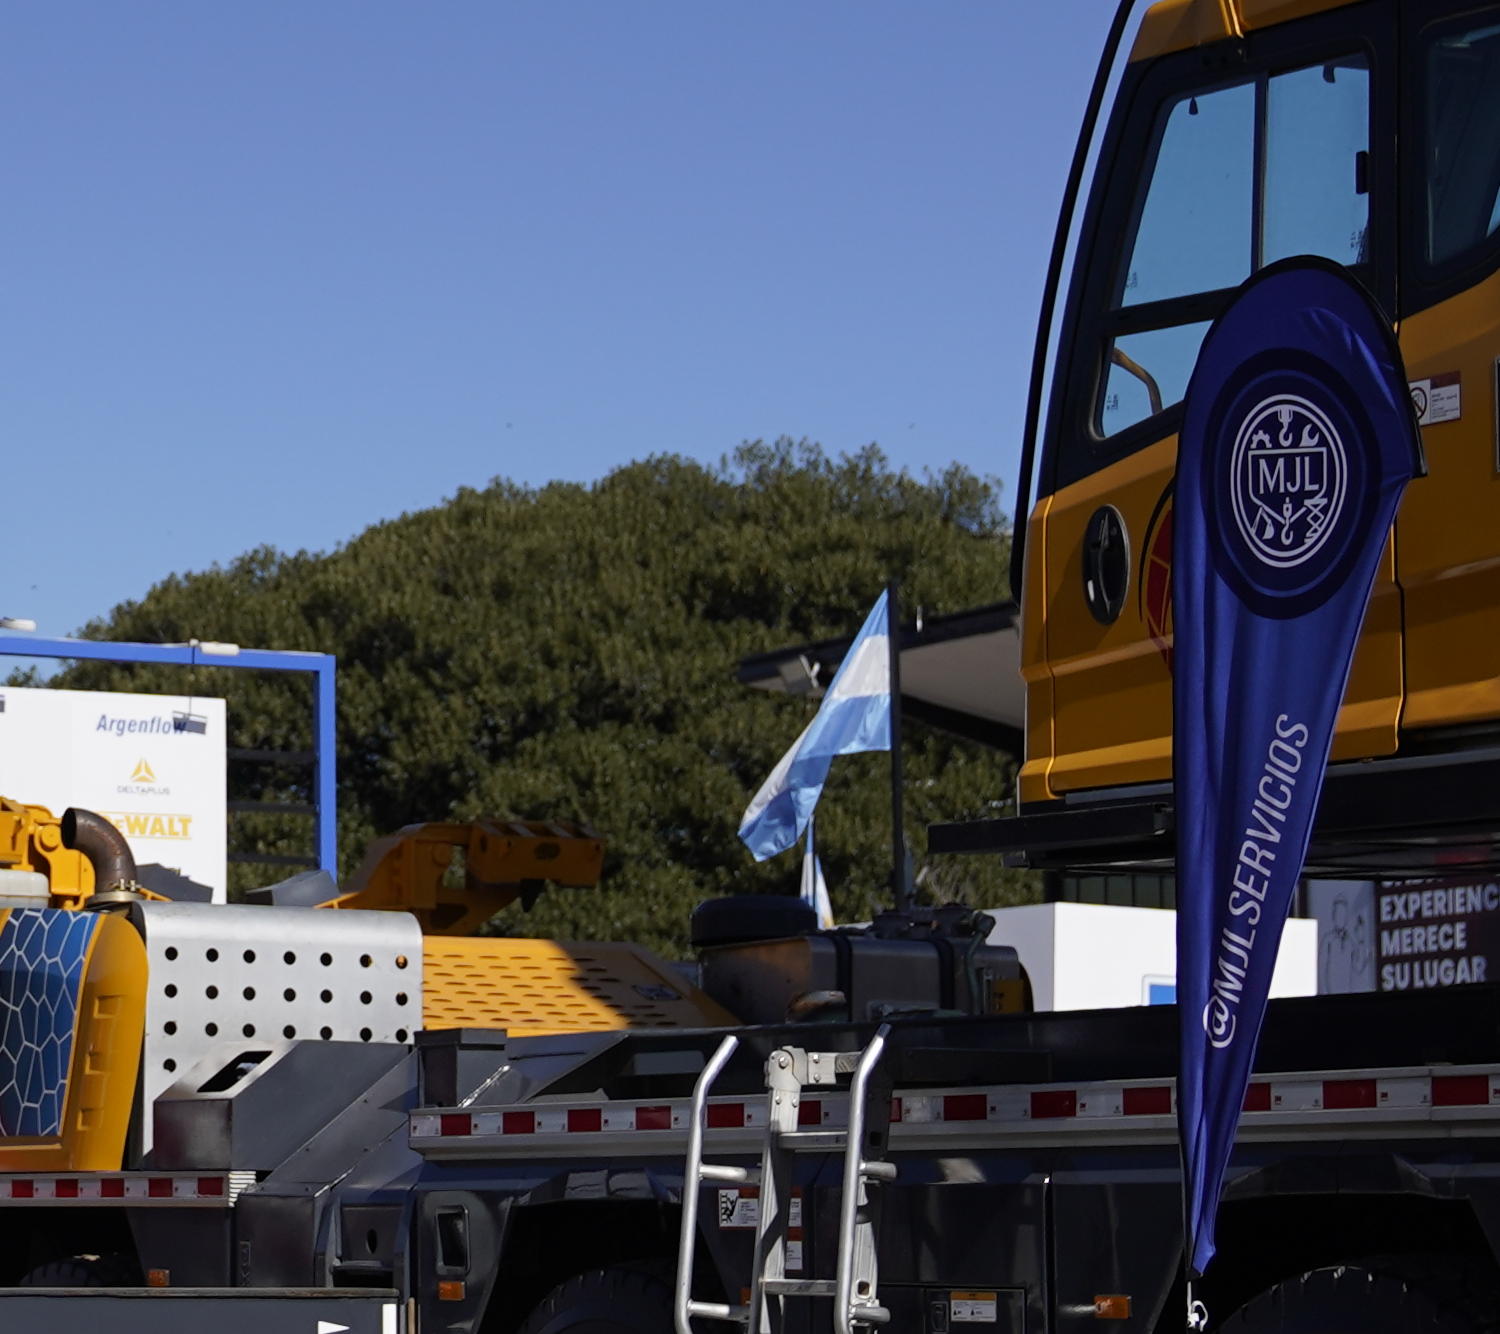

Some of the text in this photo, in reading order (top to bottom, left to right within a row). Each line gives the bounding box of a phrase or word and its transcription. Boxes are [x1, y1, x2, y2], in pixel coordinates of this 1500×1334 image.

[1259, 457, 1320, 495] MJL
[1381, 921, 1467, 957] MERECE
[1381, 955, 1488, 992] SU LUGAR
